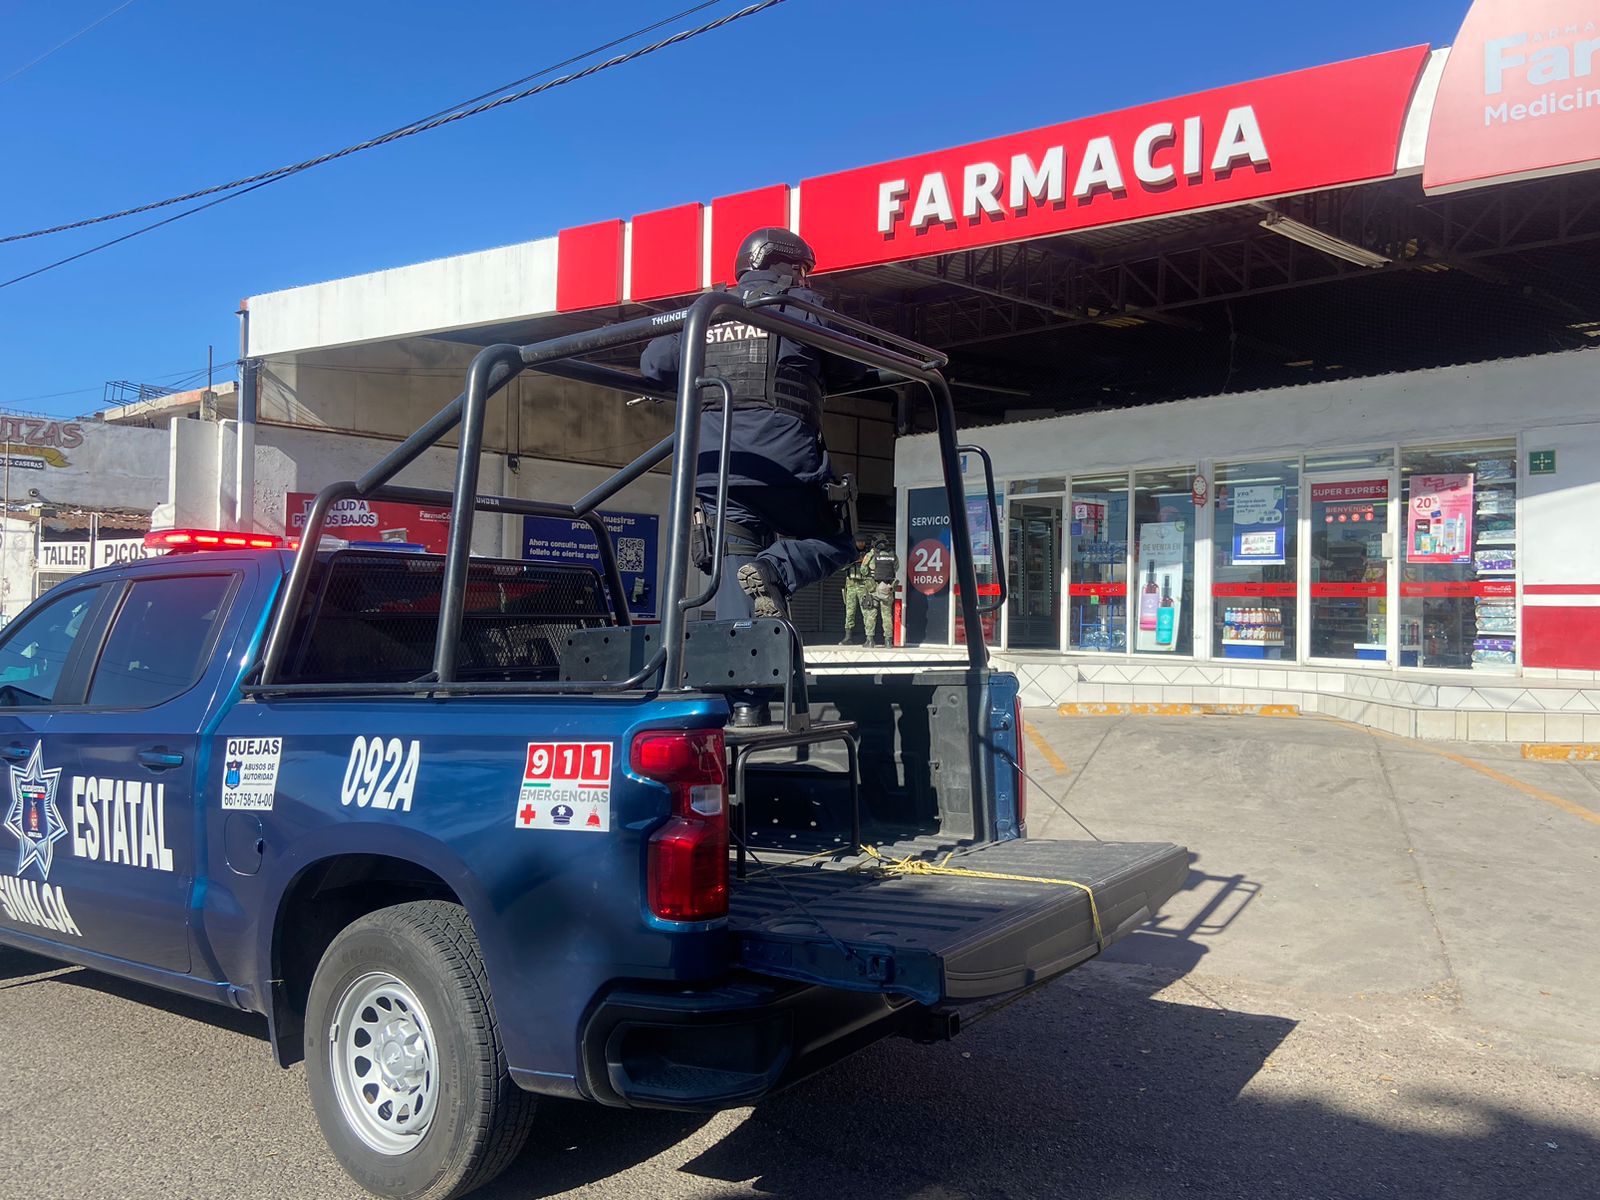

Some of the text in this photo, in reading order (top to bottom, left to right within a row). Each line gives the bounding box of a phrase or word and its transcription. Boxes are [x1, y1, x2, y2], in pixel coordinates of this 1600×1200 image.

[877, 105, 1270, 234] FARMACIA
[651, 309, 692, 326] THUNDE
[705, 325, 768, 344] STATAL
[1312, 485, 1387, 497] SUPER EXPRESS
[359, 501, 367, 511] A
[476, 497, 500, 506] UNDER
[341, 514, 375, 525] BAJOS
[603, 515, 636, 525] nuestras
[911, 515, 950, 526] SERVICIO
[529, 538, 549, 547] Ahora
[550, 541, 577, 549] consulta
[44, 546, 86, 566] TALLER
[104, 542, 149, 565] PICOS
[529, 548, 551, 556] folleto
[562, 550, 584, 559] ofertas
[914, 548, 943, 572] 24
[913, 575, 944, 585] HORAS
[228, 739, 280, 757] QUEJAS
[244, 763, 276, 771] ABUSOS DE
[530, 747, 603, 776] 911
[243, 773, 274, 781] AUTORIDAD
[340, 735, 421, 812] 092A
[224, 792, 273, 807] 667-758-74-00
[520, 788, 609, 803] EMERGENCIAS
[72, 775, 174, 872] ESTATAL
